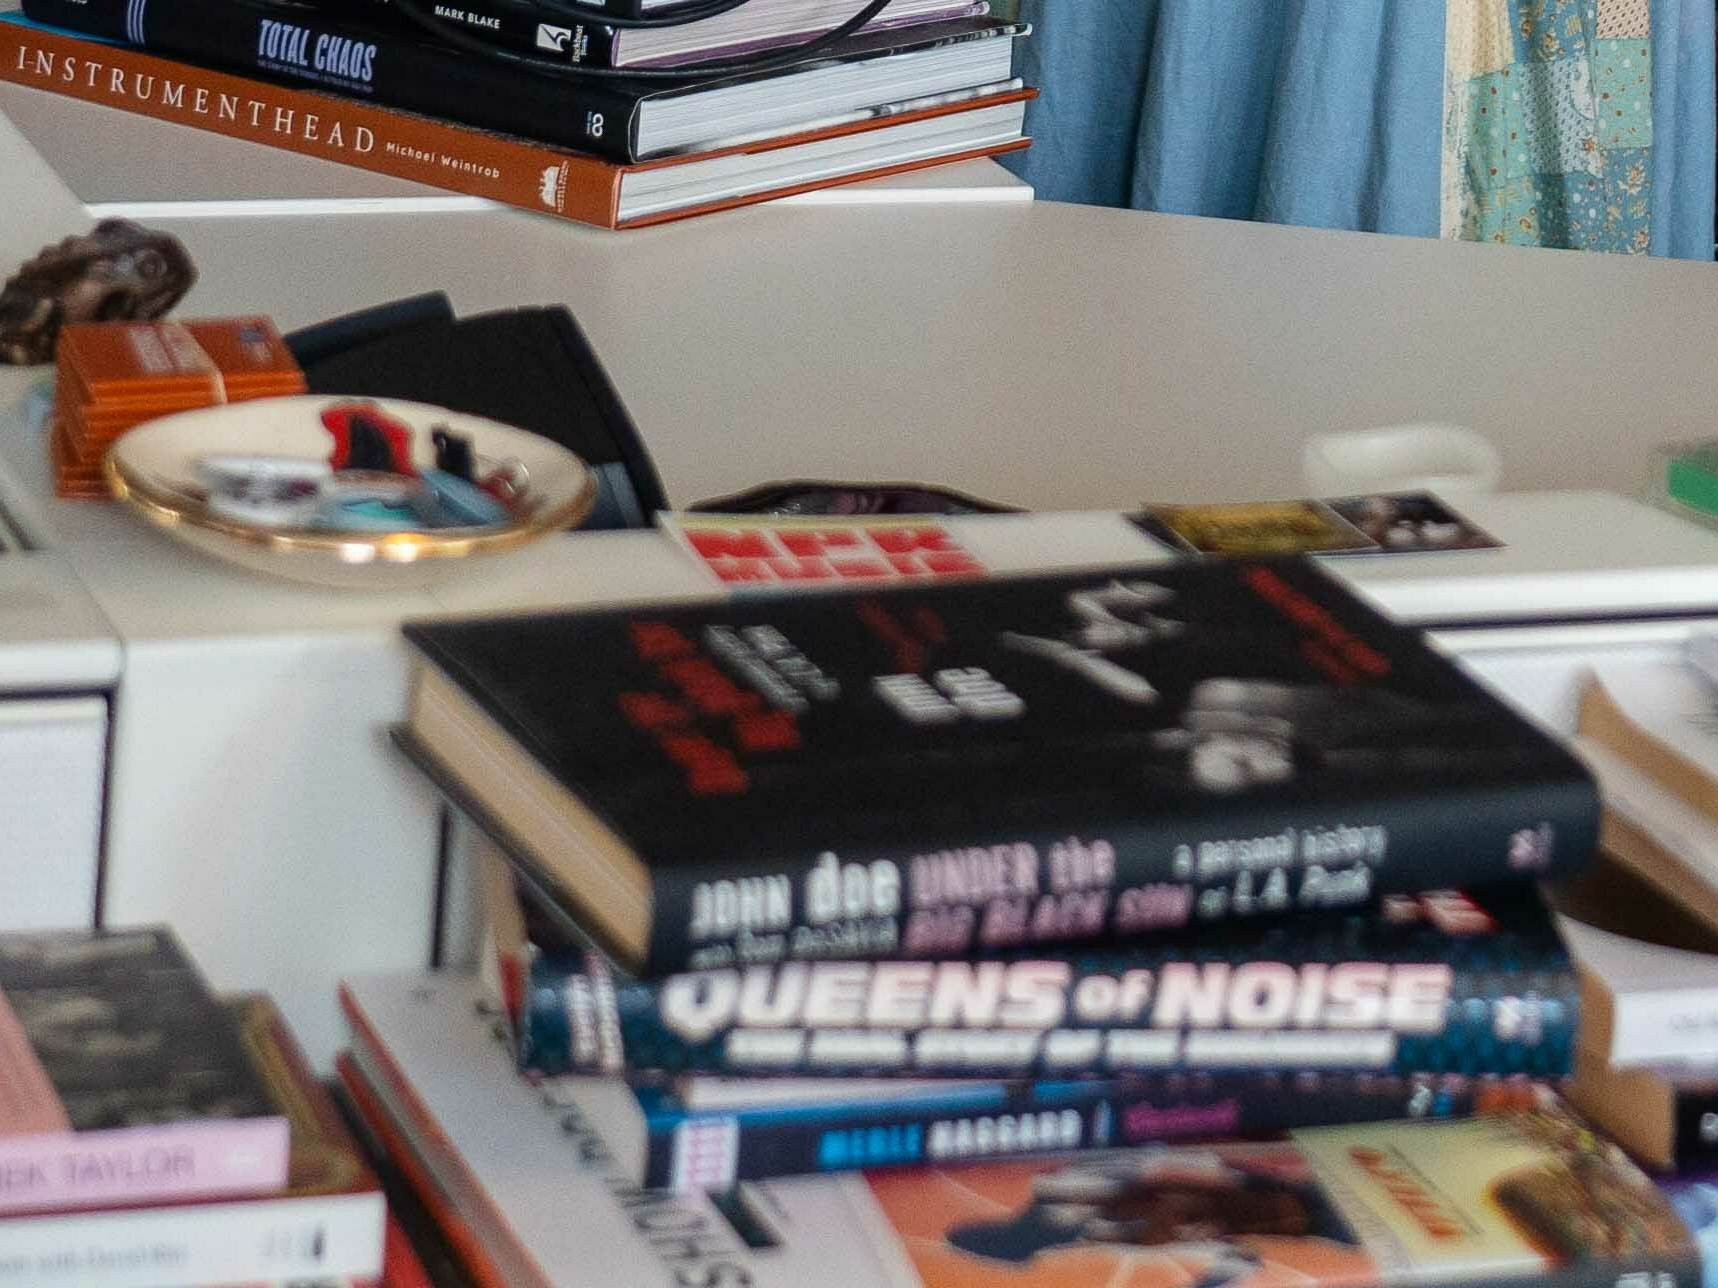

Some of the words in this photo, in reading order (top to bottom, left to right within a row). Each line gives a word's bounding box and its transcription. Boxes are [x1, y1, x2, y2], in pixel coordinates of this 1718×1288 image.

[259, 17, 311, 65] TOTAL
[313, 29, 378, 83] CHAOS
[434, 4, 465, 21] MARK
[467, 12, 501, 30] BLAKE
[16, 45, 376, 154] INSTRUMENTHEAD
[385, 140, 434, 162] Michael
[441, 153, 502, 180] Weintrob
[691, 873, 792, 942] JOHN
[803, 851, 902, 921] doe
[909, 841, 1040, 908] UNDER
[1047, 835, 1116, 895] the
[905, 906, 979, 955] BIG
[981, 889, 1111, 946] BLACK
[662, 958, 1071, 1037] QUEENS
[1074, 968, 1156, 1017] of
[1156, 962, 1451, 1030] NOISE
[63, 1147, 197, 1185] TAYLOR
